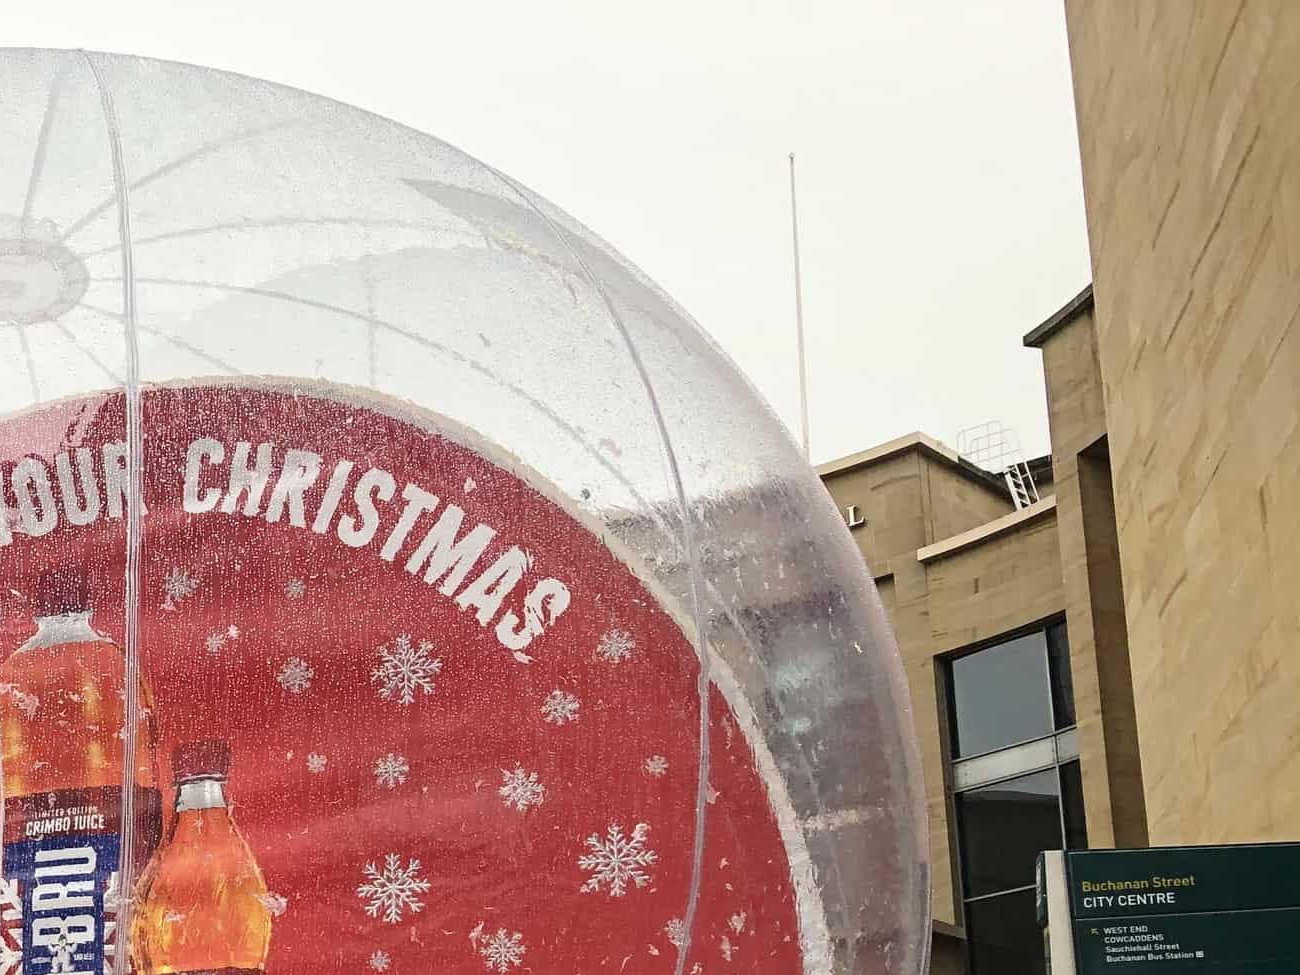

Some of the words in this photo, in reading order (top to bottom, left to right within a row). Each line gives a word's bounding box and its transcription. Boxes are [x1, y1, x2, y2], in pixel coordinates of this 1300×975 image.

[181, 437, 571, 655] CHRISTMAS
[26, 817, 71, 836] CRIMBO
[74, 815, 105, 831] JUICE
[1082, 878, 1149, 892] Buchanan
[1152, 874, 1196, 888] Street
[1083, 895, 1114, 909] CITY
[1117, 892, 1176, 907] CENTRE
[1103, 926, 1128, 935] WEST
[1129, 925, 1148, 934] END
[1104, 934, 1164, 944] COWCADDENS
[1154, 943, 1180, 951] Street
[1106, 954, 1146, 963] Buchanan
[1148, 952, 1163, 961] Bus
[1165, 951, 1194, 960] Station
